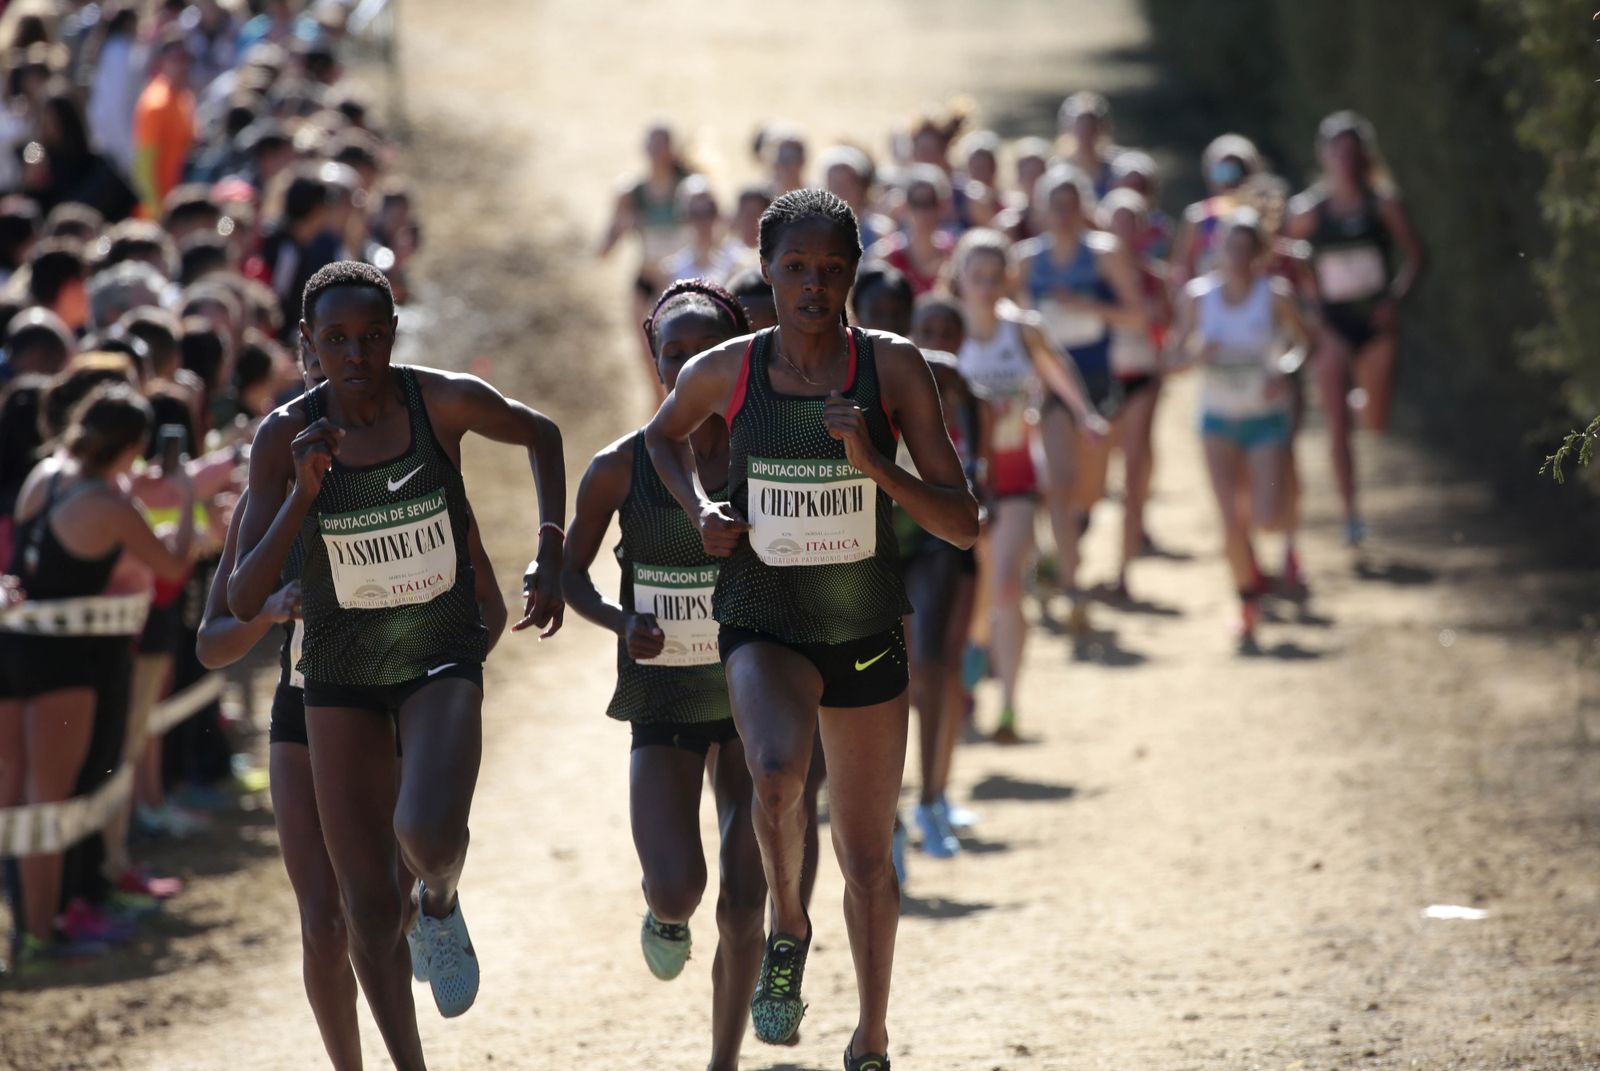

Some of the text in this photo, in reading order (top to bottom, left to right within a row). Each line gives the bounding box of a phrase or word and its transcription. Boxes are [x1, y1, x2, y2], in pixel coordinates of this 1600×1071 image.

[752, 461, 863, 477] DIPUTACION DE SEVIL
[324, 496, 444, 530] DIPUTACION DE SEVILLA
[761, 485, 863, 518] CHEPKOECH
[332, 532, 413, 566] YASMINE
[415, 519, 446, 555] CAN
[806, 538, 859, 552] ITÁLICA
[392, 573, 443, 594] ITÁLICA
[637, 568, 698, 584] DIPUTACION
[700, 570, 713, 582] DE
[653, 593, 714, 621] CHEPS
